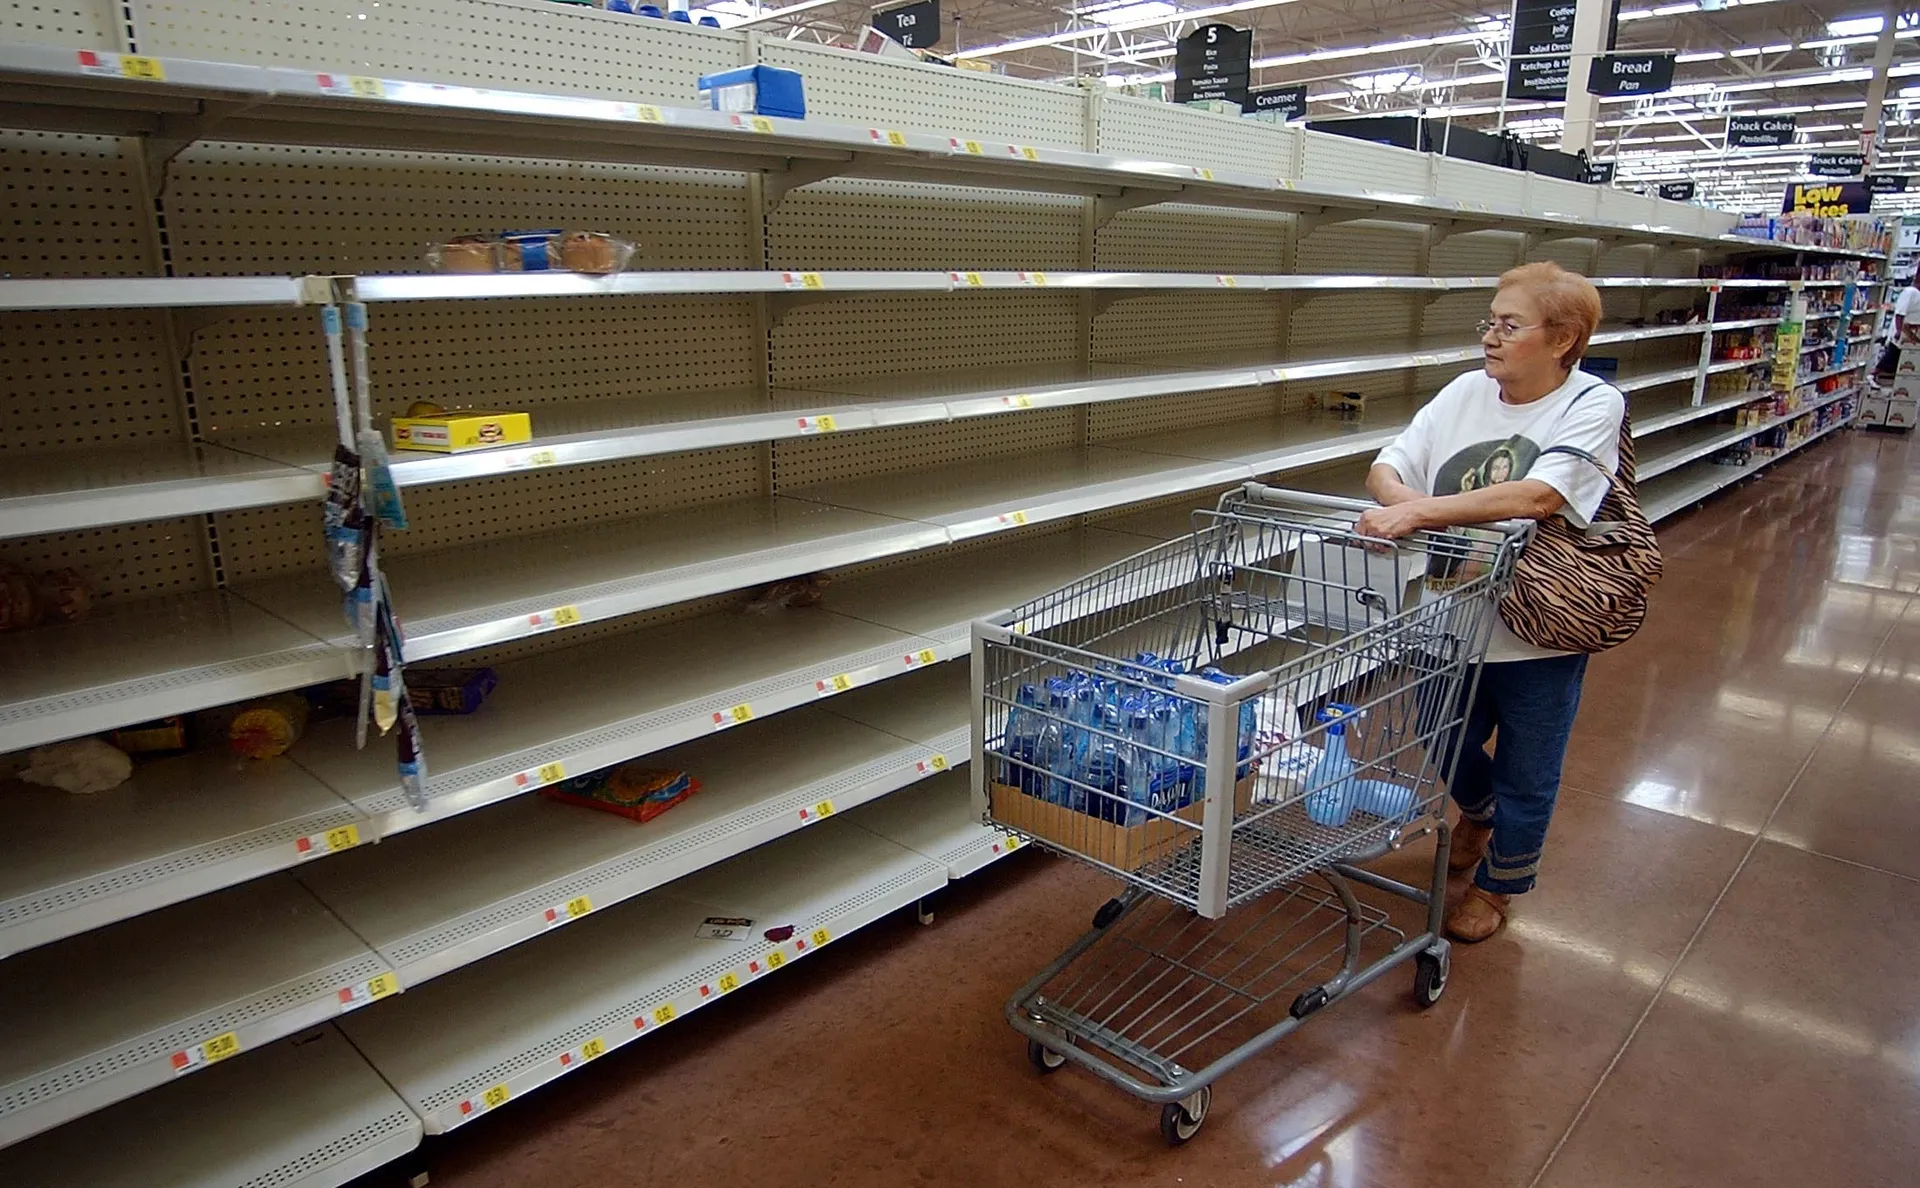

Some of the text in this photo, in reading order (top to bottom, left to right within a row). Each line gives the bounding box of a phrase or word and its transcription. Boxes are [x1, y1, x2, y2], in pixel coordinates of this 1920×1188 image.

[896, 13, 917, 28] Tea
[902, 33, 914, 46] Té
[1207, 27, 1217, 43] 5
[1528, 44, 1550, 54] Salad
[1520, 61, 1552, 71] Ketchup
[1552, 59, 1561, 69] &
[1612, 60, 1653, 75] Bread
[1619, 79, 1640, 91] Pan
[1256, 93, 1298, 106] Creamer
[1730, 120, 1793, 132] Snack Cakes
[1812, 155, 1864, 165] Snack Cakes
[1794, 184, 1844, 204] Low
